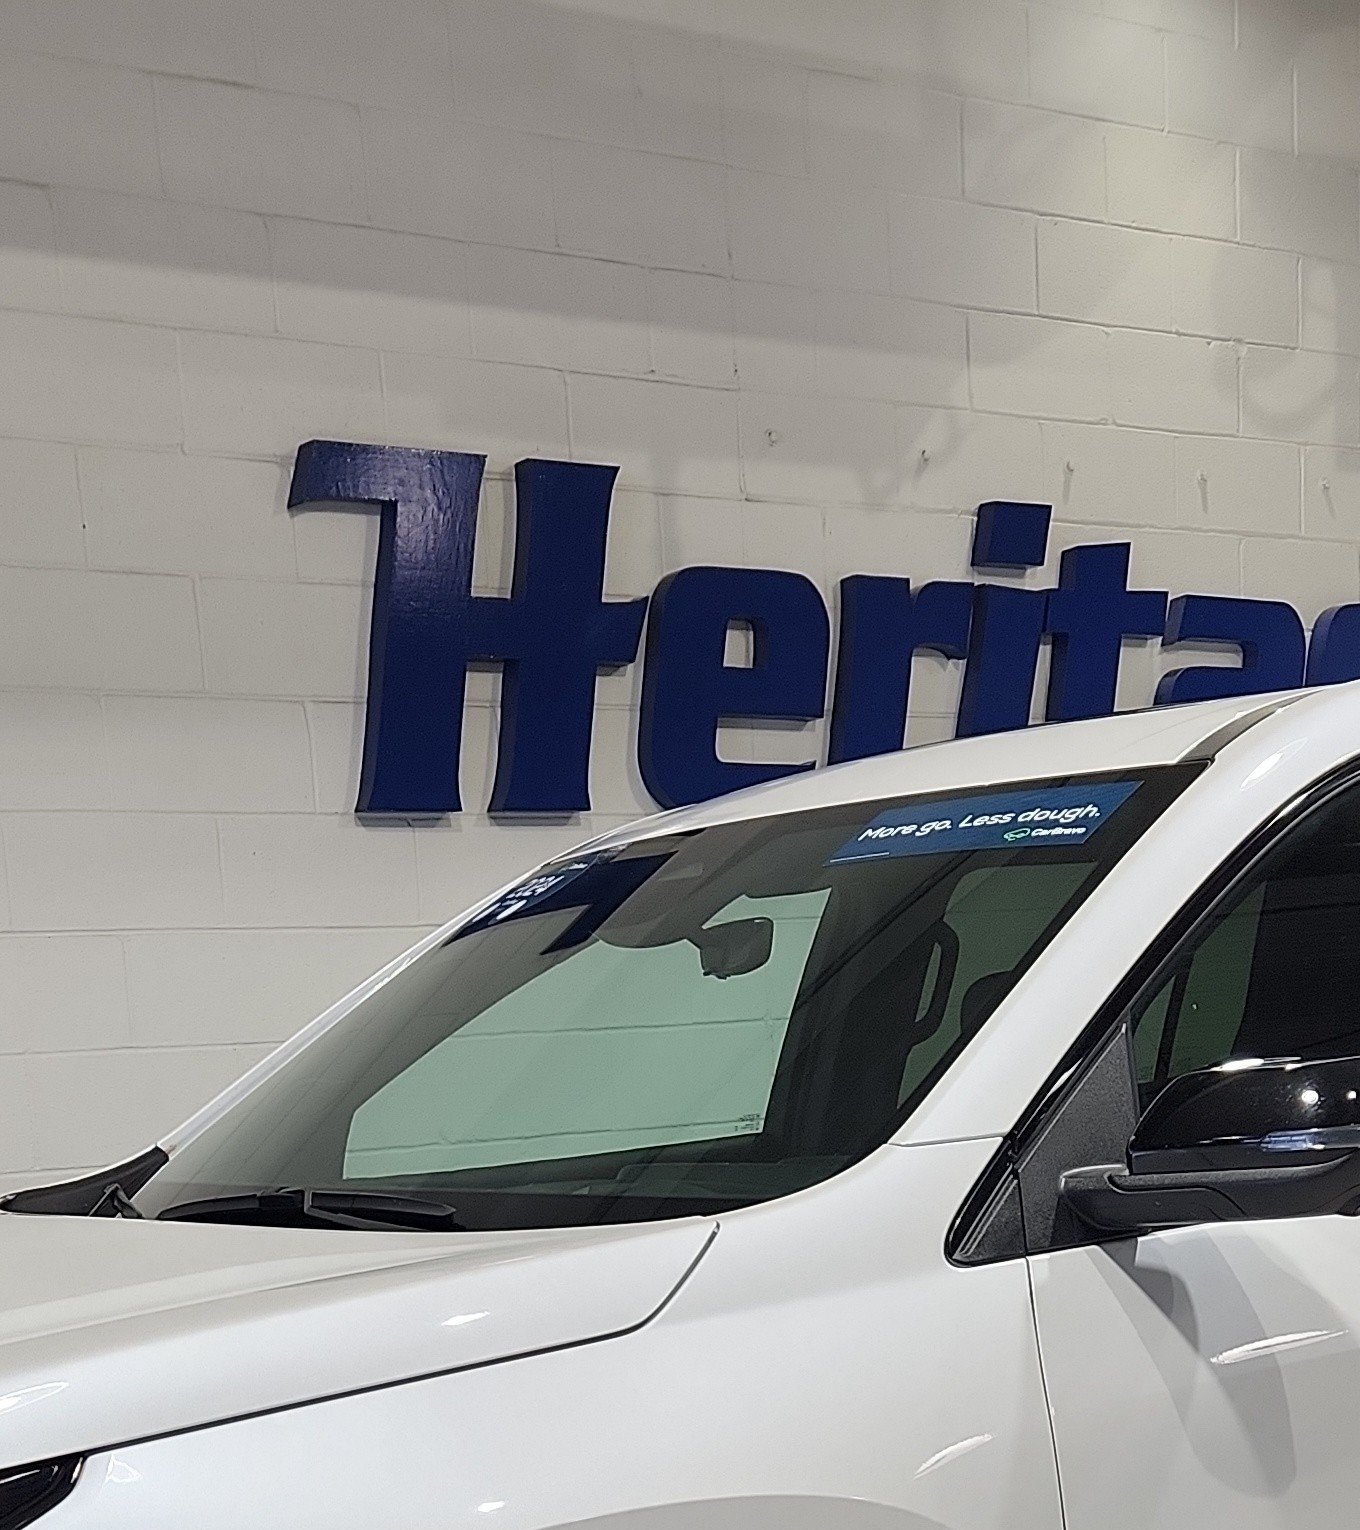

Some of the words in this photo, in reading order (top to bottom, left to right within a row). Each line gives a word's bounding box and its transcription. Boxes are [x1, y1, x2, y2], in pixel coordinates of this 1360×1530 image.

[857, 825, 913, 842] More
[915, 820, 952, 838] go.
[959, 810, 1016, 829] Less
[1018, 804, 1101, 824] dough.
